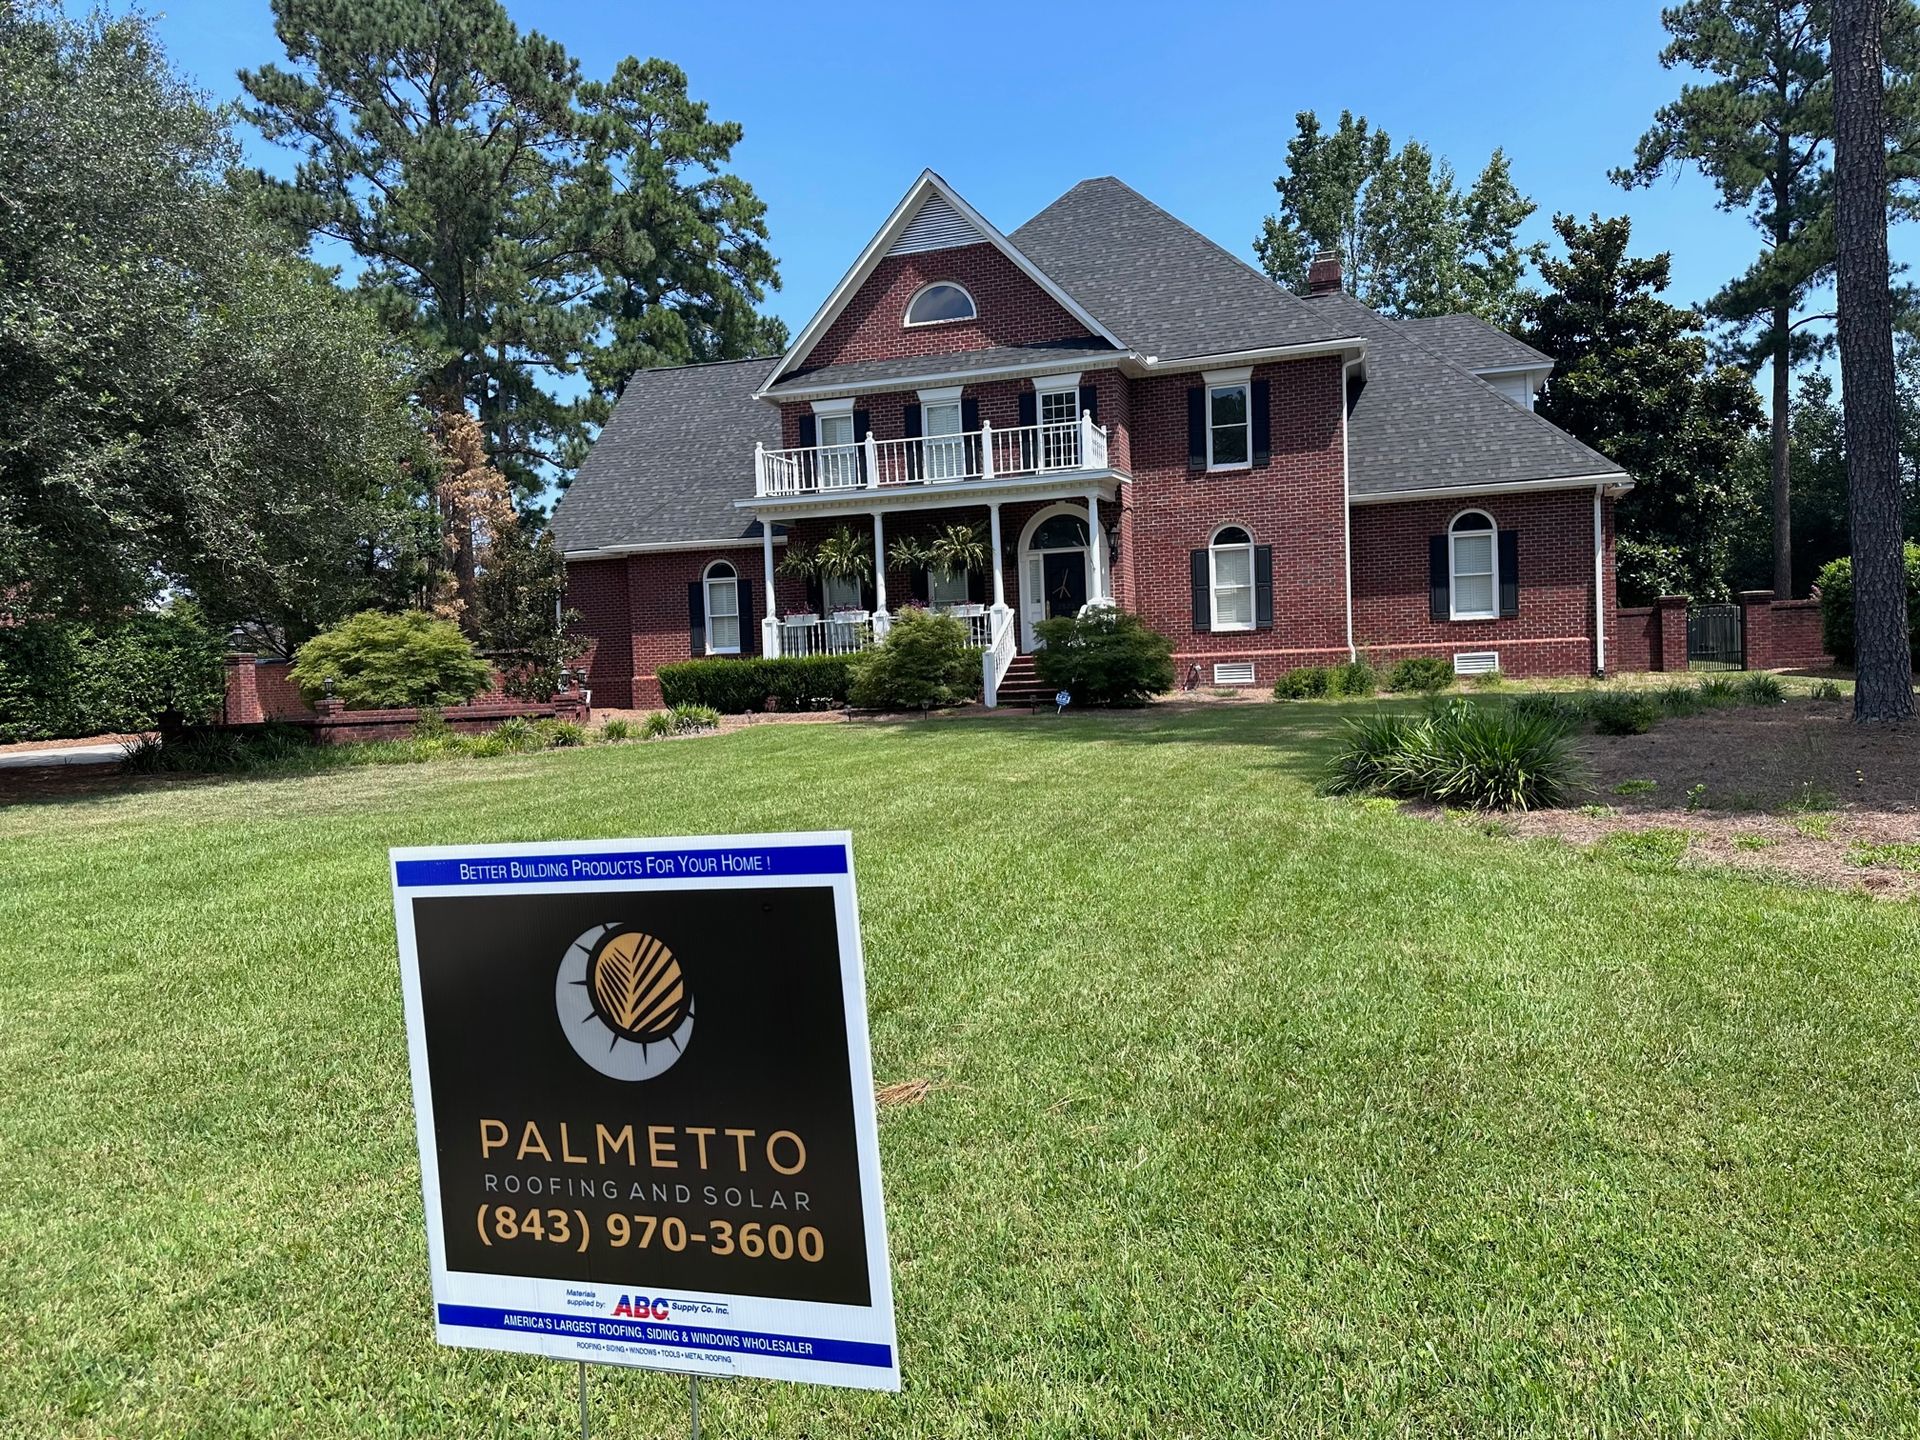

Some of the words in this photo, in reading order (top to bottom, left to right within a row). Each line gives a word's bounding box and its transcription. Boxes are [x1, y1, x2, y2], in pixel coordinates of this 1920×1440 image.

[460, 864, 507, 880] BETTER
[510, 862, 568, 878] BUILDING
[572, 859, 642, 876] PRODUCTS
[646, 857, 674, 874] FOR
[678, 855, 717, 873] YOUR
[479, 1119, 807, 1175] PALMETTO
[485, 1174, 618, 1199] ROOFING
[629, 1182, 691, 1203] AND
[703, 1186, 811, 1211] SOLAR
[476, 1204, 590, 1253] (843)
[606, 1213, 825, 1263] 970-3600
[566, 1289, 596, 1298] Materials
[567, 1299, 594, 1307] supplied
[611, 1294, 669, 1320] ABC
[672, 1303, 699, 1313] Supply
[701, 1305, 713, 1313] Co.
[715, 1306, 729, 1315] Inc.
[504, 1314, 552, 1329] AMERICA'S
[554, 1320, 596, 1333] LARGEST
[600, 1323, 645, 1340] ROOFING,
[646, 1328, 679, 1341] SIDING
[682, 1331, 689, 1342] &
[690, 1332, 740, 1347] WINDOWS
[742, 1336, 813, 1355] WHOLESALER
[577, 1341, 601, 1351] ROOFING
[606, 1344, 625, 1353] SIDING
[628, 1346, 657, 1356] WINDOWS
[662, 1350, 680, 1359] TOOLS
[684, 1352, 704, 1361] METAL
[705, 1354, 732, 1363] ROOFING
